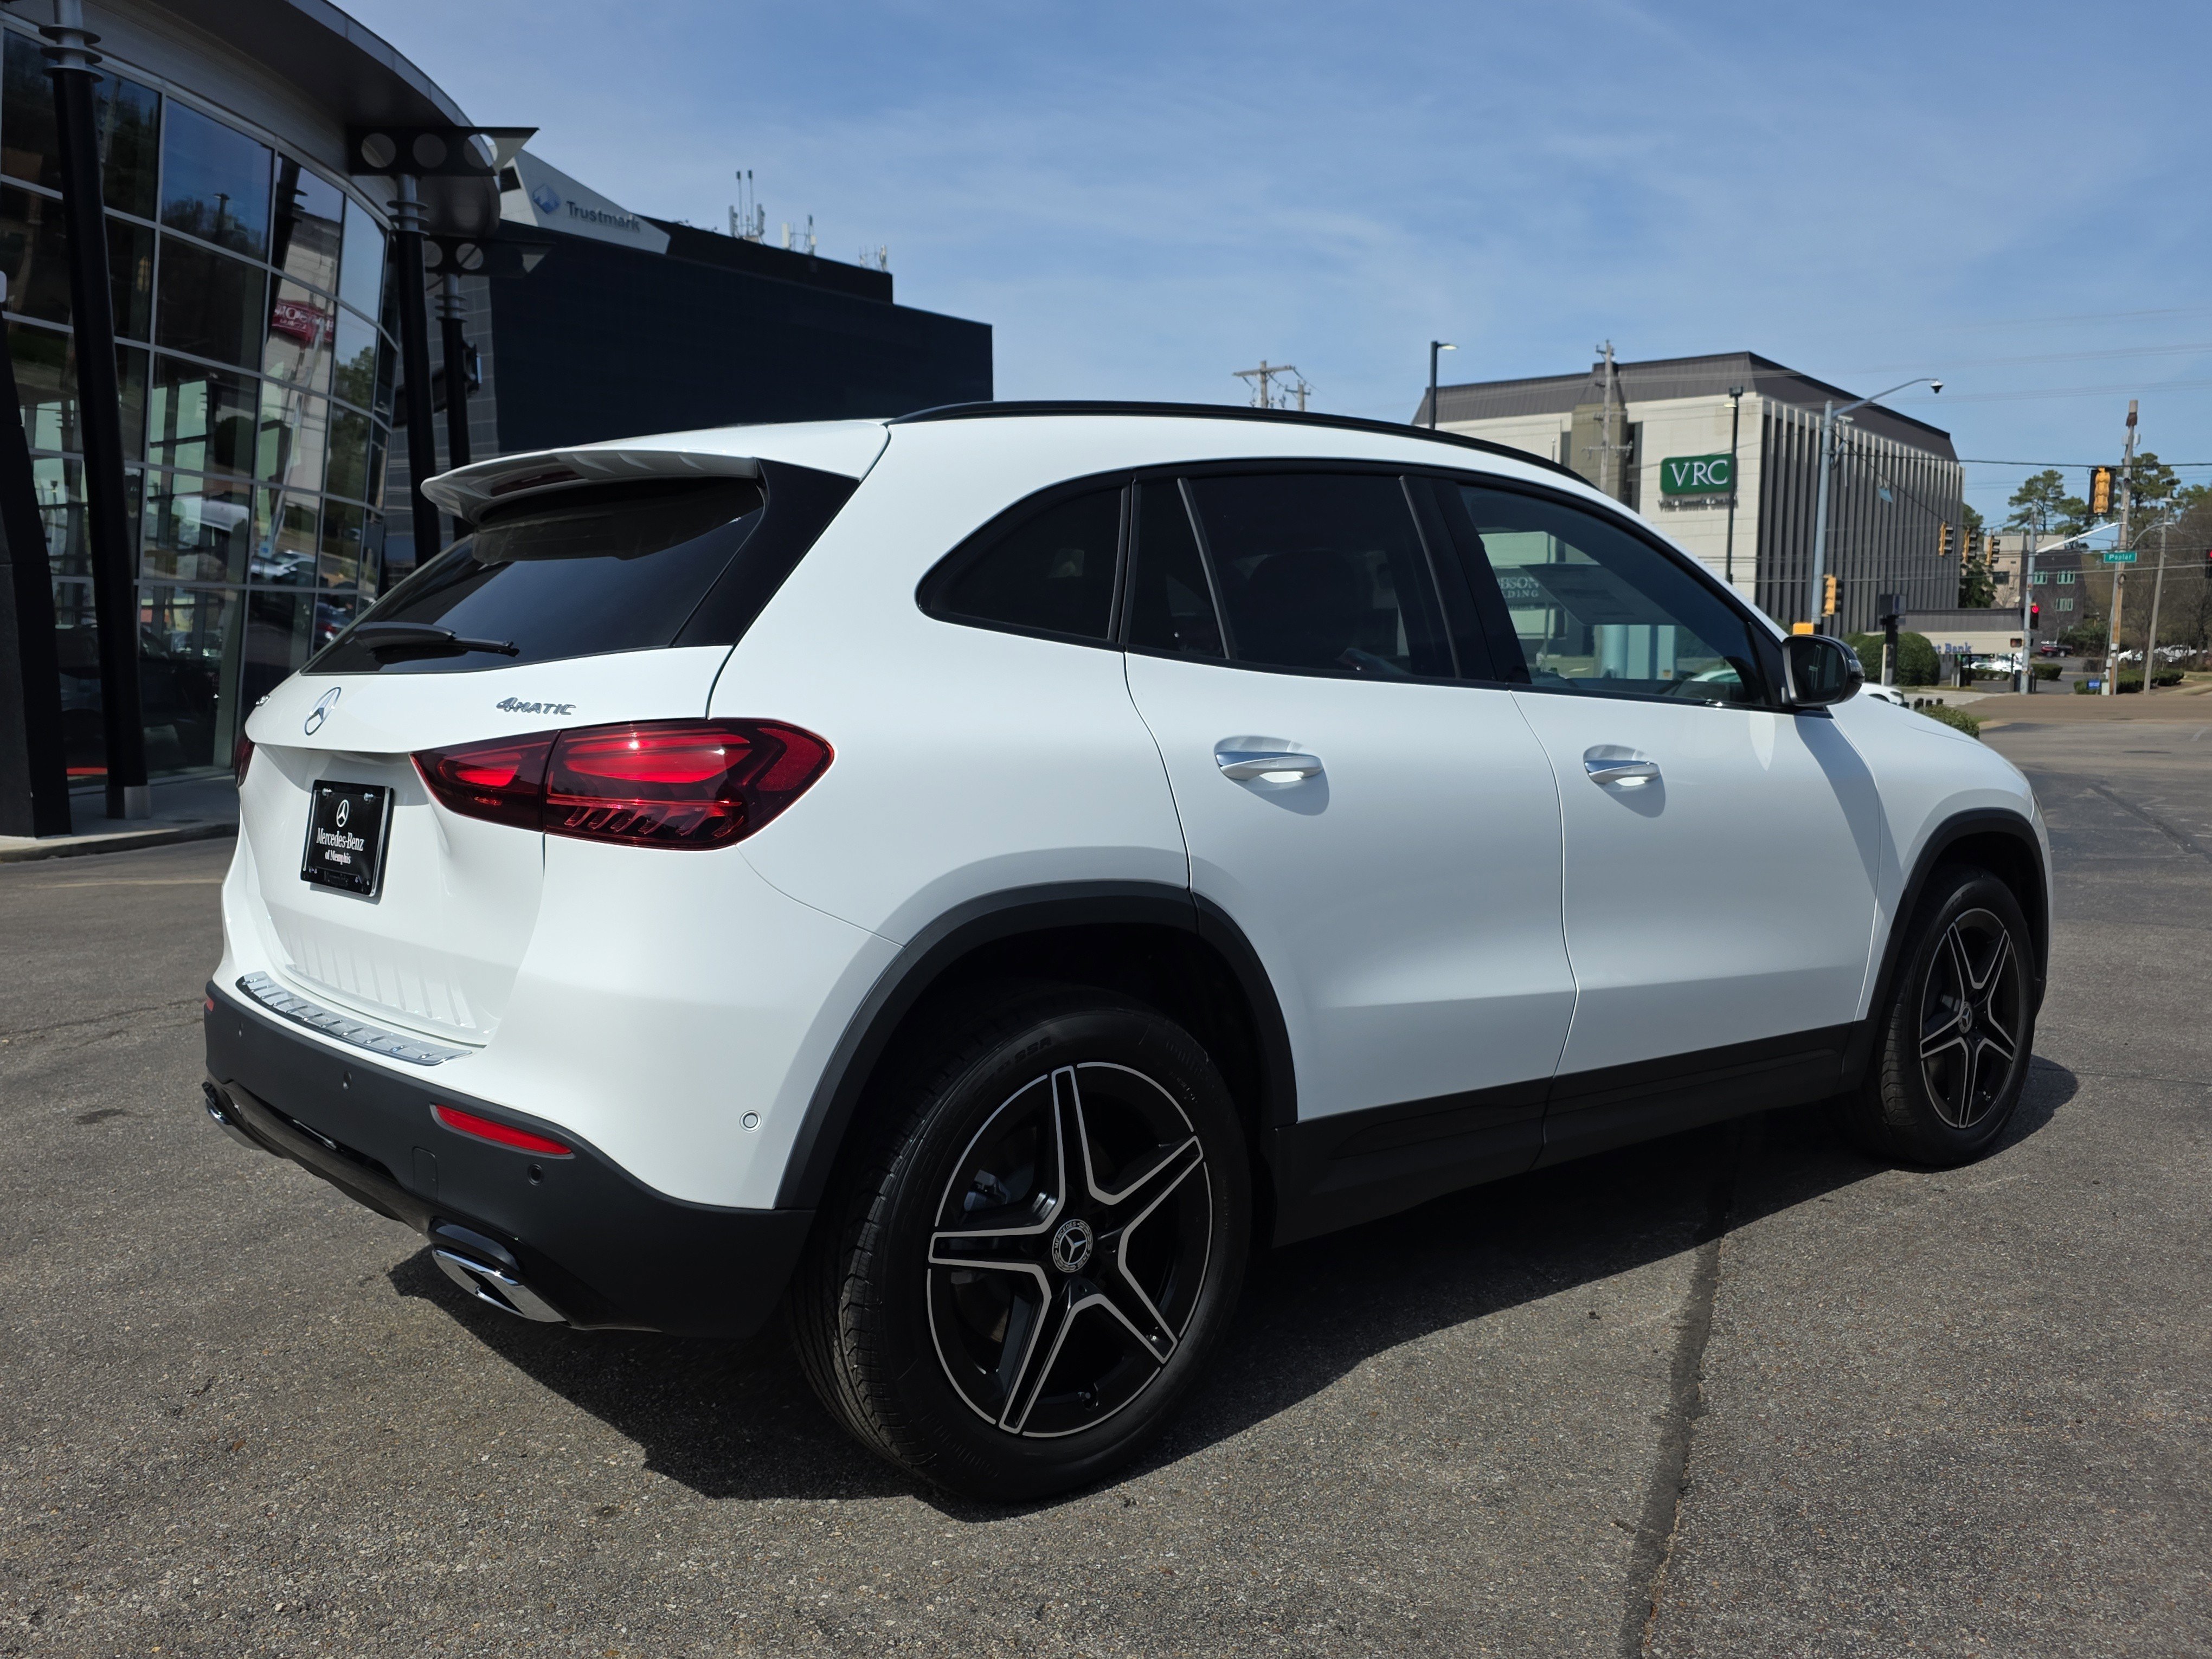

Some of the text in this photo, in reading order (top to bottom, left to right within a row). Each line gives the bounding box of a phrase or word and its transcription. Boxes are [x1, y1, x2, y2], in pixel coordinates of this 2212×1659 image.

[566, 201, 640, 232] Trustmark
[1669, 459, 1728, 487] VRC
[1945, 642, 1972, 654] Bank
[496, 697, 576, 715] 4MATIC
[316, 827, 364, 851] Mercedes-Benz
[325, 850, 351, 865] of Memphis
[1054, 1221, 1076, 1249] MERCEDES
